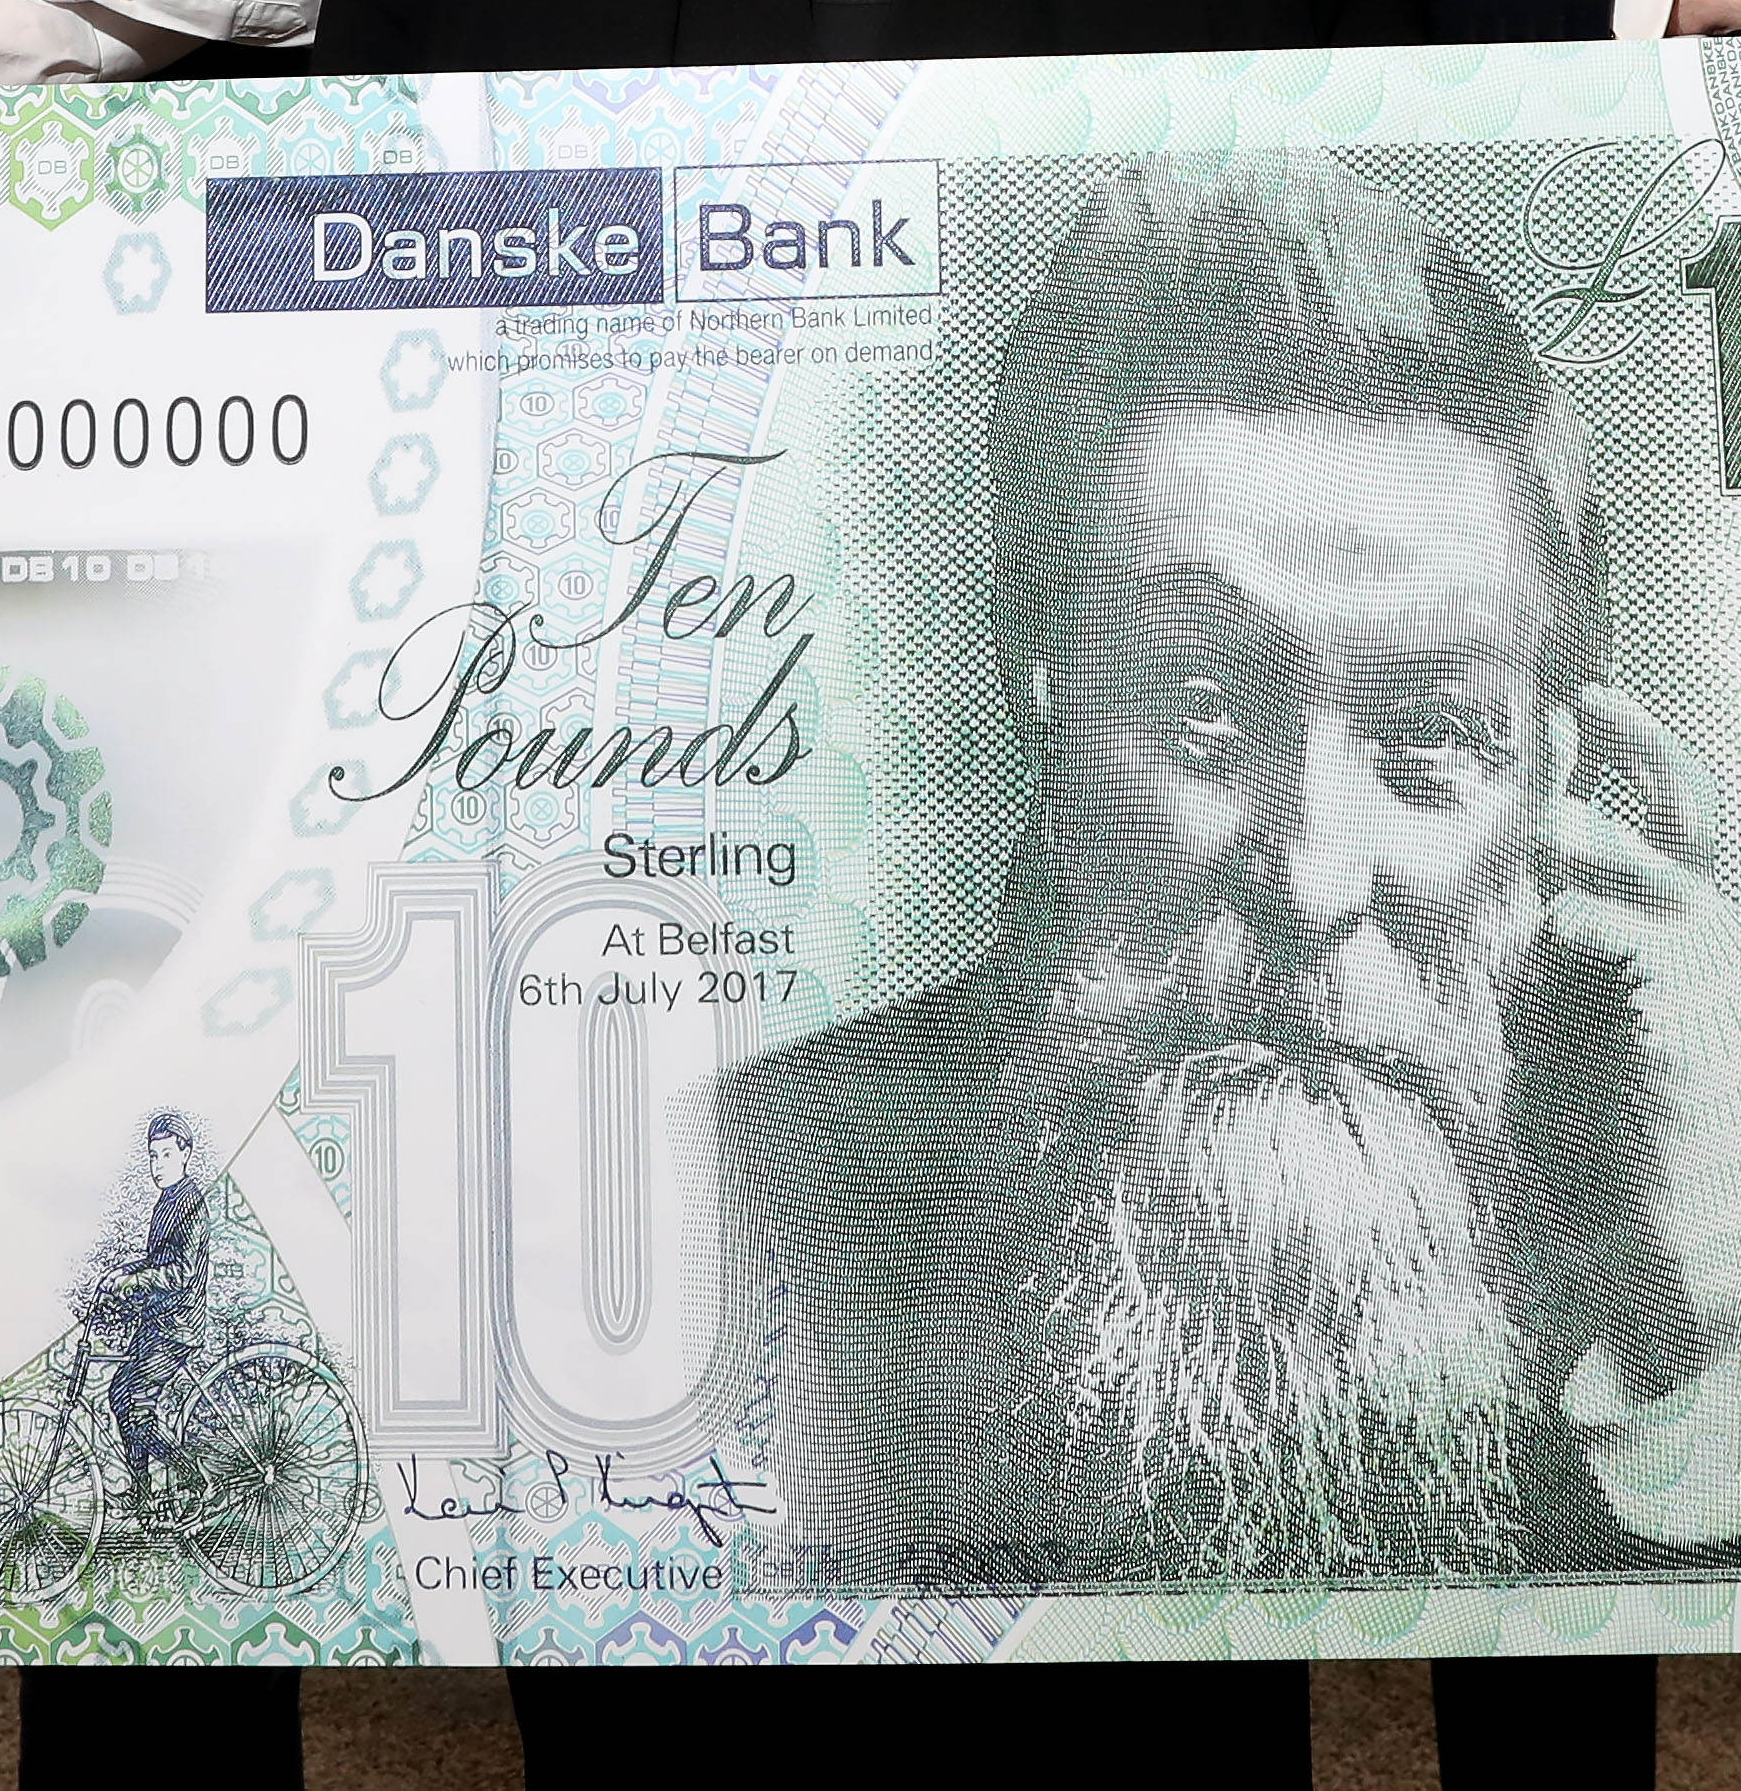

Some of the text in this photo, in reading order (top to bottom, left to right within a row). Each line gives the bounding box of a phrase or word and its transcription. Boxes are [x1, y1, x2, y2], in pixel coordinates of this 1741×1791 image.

[38, 160, 67, 175] DB
[210, 155, 239, 170] DB
[312, 199, 915, 282] Danske Bank
[496, 304, 932, 340] a trading name of Northern Bank Limited
[448, 340, 932, 377] which promises to pay the bearer on demand
[526, 397, 547, 412] 10
[529, 448, 814, 649] Ten
[565, 577, 586, 595] 10
[328, 601, 813, 803] Pounds
[457, 796, 478, 819] 10
[603, 834, 797, 886] Sterling
[602, 923, 794, 956] At Belfast
[519, 969, 797, 1014] 6th July 2017
[298, 849, 765, 1478] 10
[315, 1145, 337, 1174] 10
[415, 1555, 516, 1589] Chief
[534, 1555, 723, 1591] Executive
